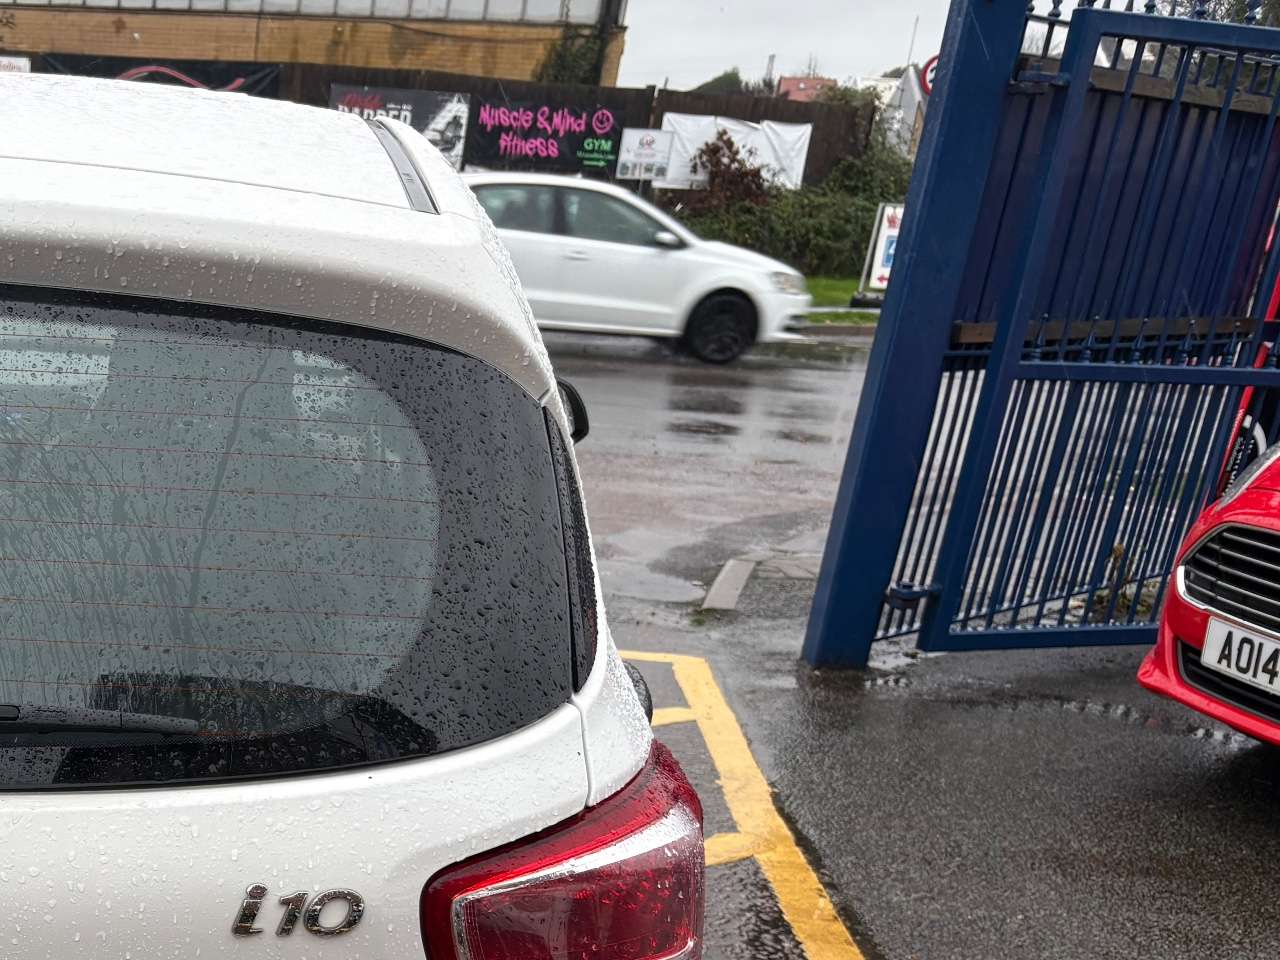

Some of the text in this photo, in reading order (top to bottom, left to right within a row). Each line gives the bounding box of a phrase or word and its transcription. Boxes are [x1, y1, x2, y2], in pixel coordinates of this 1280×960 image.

[478, 104, 587, 137] Muscle & Mind
[499, 131, 559, 158] Fitness
[583, 138, 612, 151] GYM
[1217, 630, 1279, 685] AO14
[231, 883, 365, 937] i10
